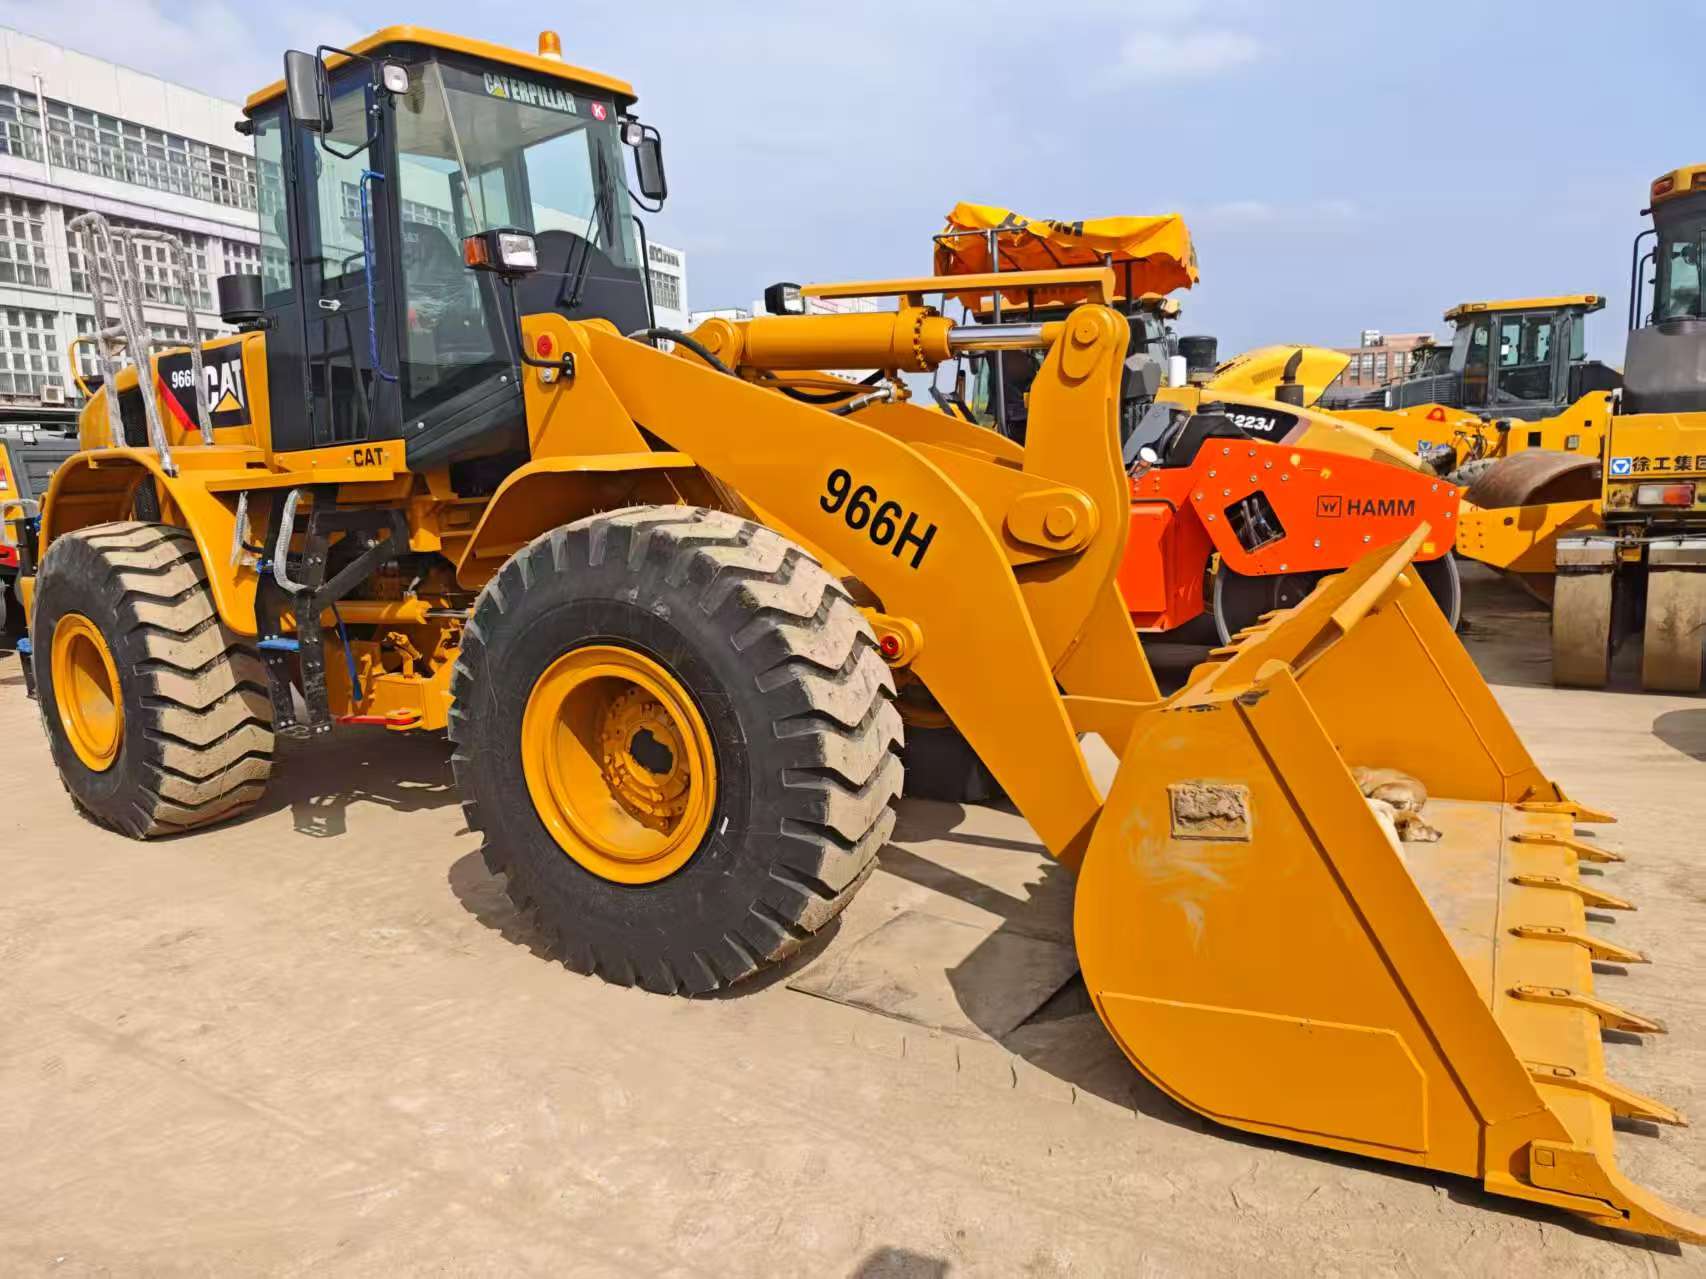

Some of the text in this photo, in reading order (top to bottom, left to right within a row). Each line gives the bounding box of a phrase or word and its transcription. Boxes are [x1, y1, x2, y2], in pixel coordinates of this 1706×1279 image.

[483, 73, 577, 113] CATERPILLAR
[203, 358, 245, 413] CAT
[353, 447, 384, 467] CAT
[820, 468, 938, 570] 966H
[1347, 498, 1416, 517] HAMM
